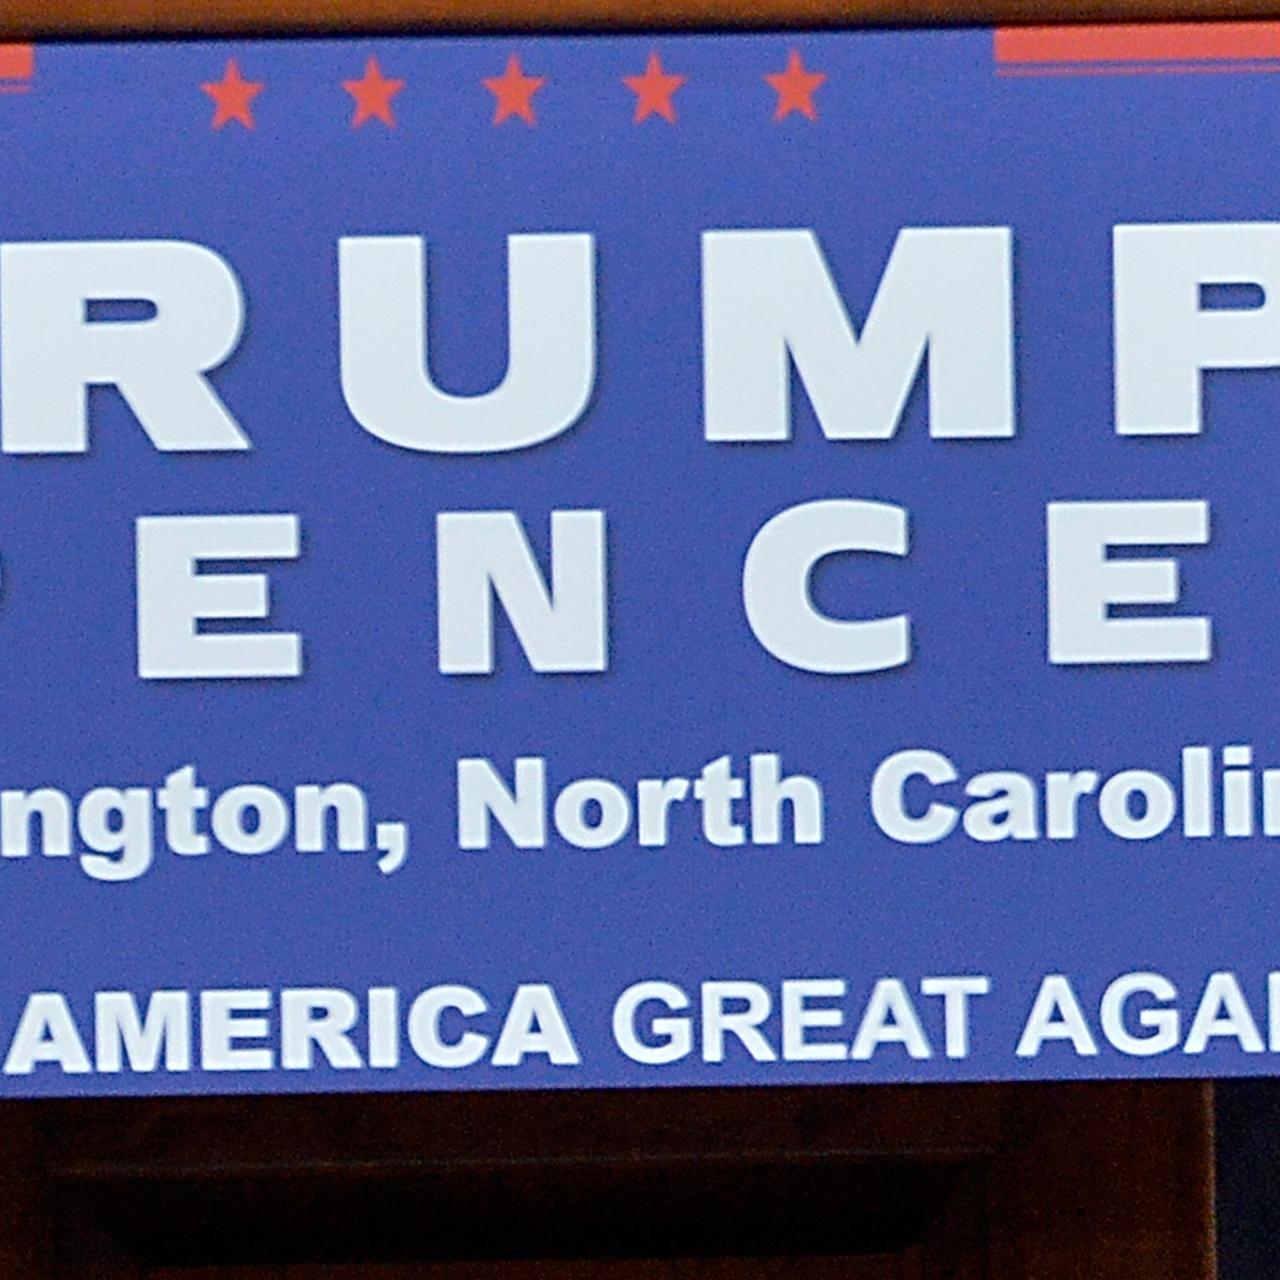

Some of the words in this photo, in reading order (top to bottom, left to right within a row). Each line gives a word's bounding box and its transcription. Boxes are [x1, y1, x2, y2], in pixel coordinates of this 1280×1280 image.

[457, 753, 822, 849] North
[3, 984, 580, 1075] AMERICA
[612, 976, 989, 1064] GREAT
